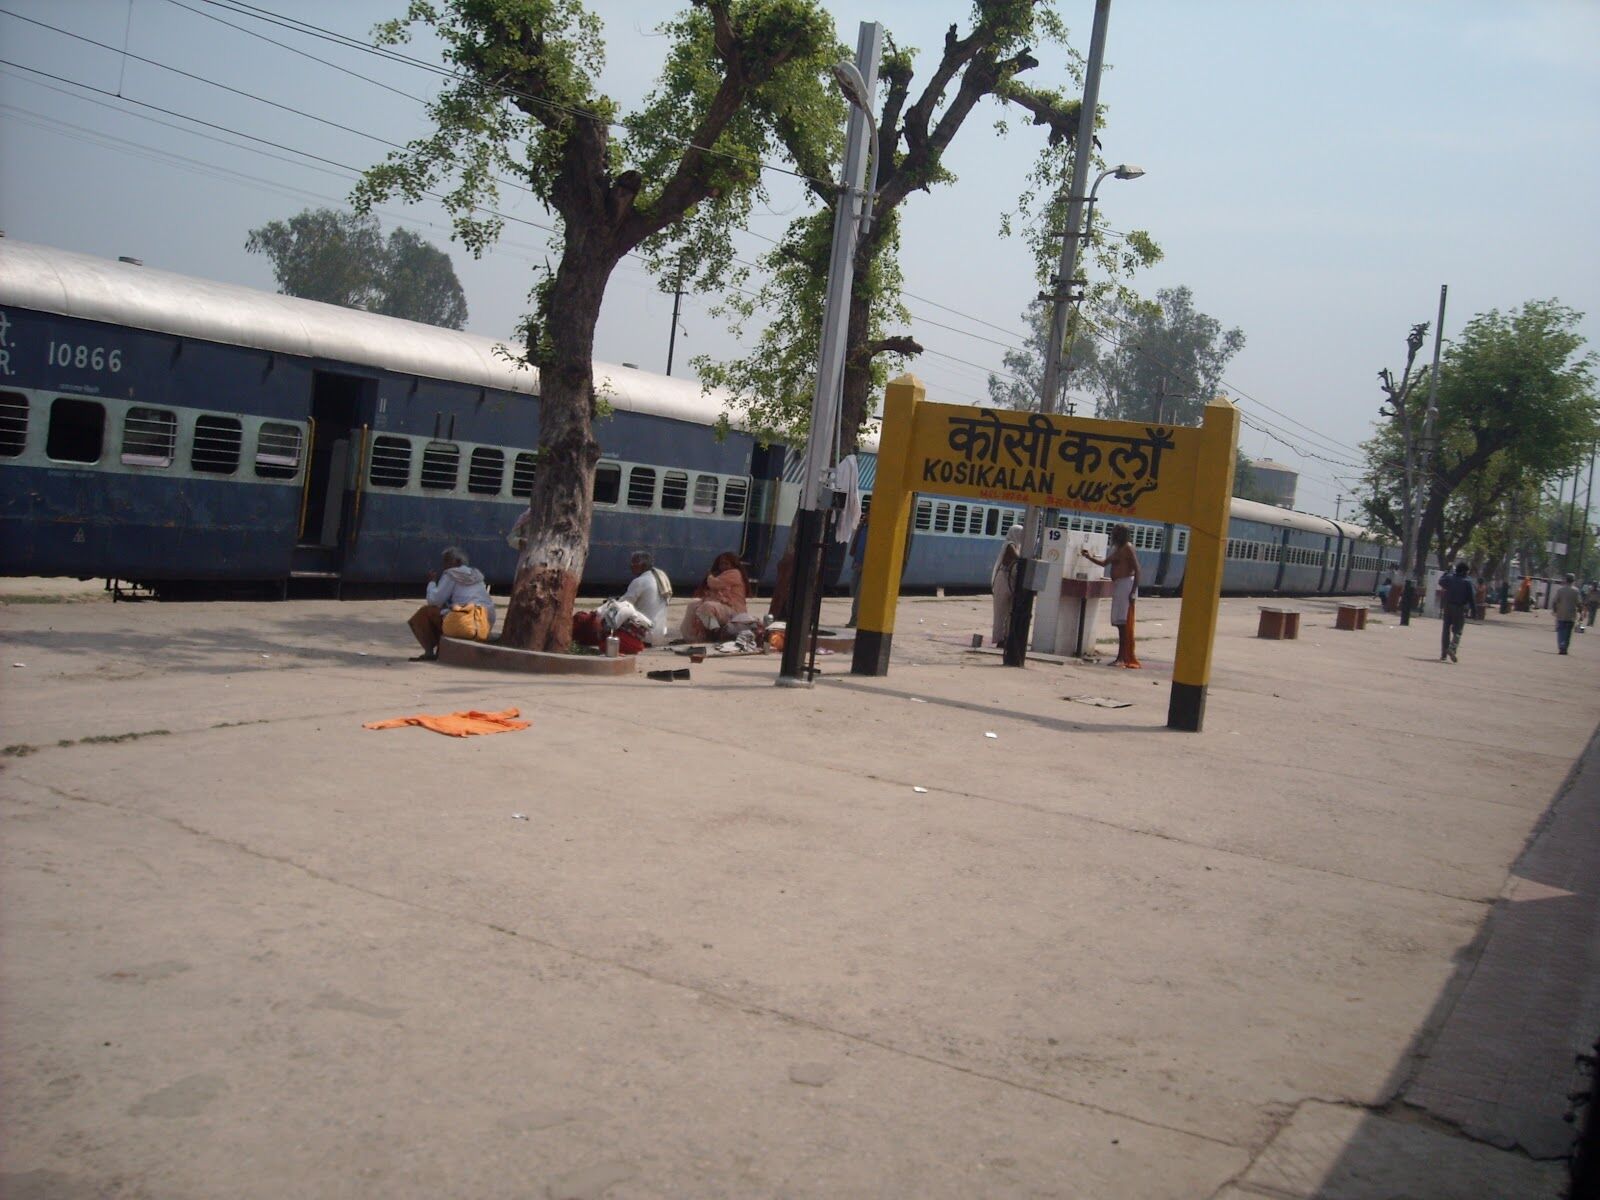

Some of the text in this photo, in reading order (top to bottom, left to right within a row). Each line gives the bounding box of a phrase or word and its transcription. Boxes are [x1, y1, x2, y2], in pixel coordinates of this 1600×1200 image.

[49, 341, 122, 373] 10866
[948, 408, 1062, 471] कोसी
[922, 457, 1055, 495] KOSIKALAN
[1049, 530, 1061, 541] 19
